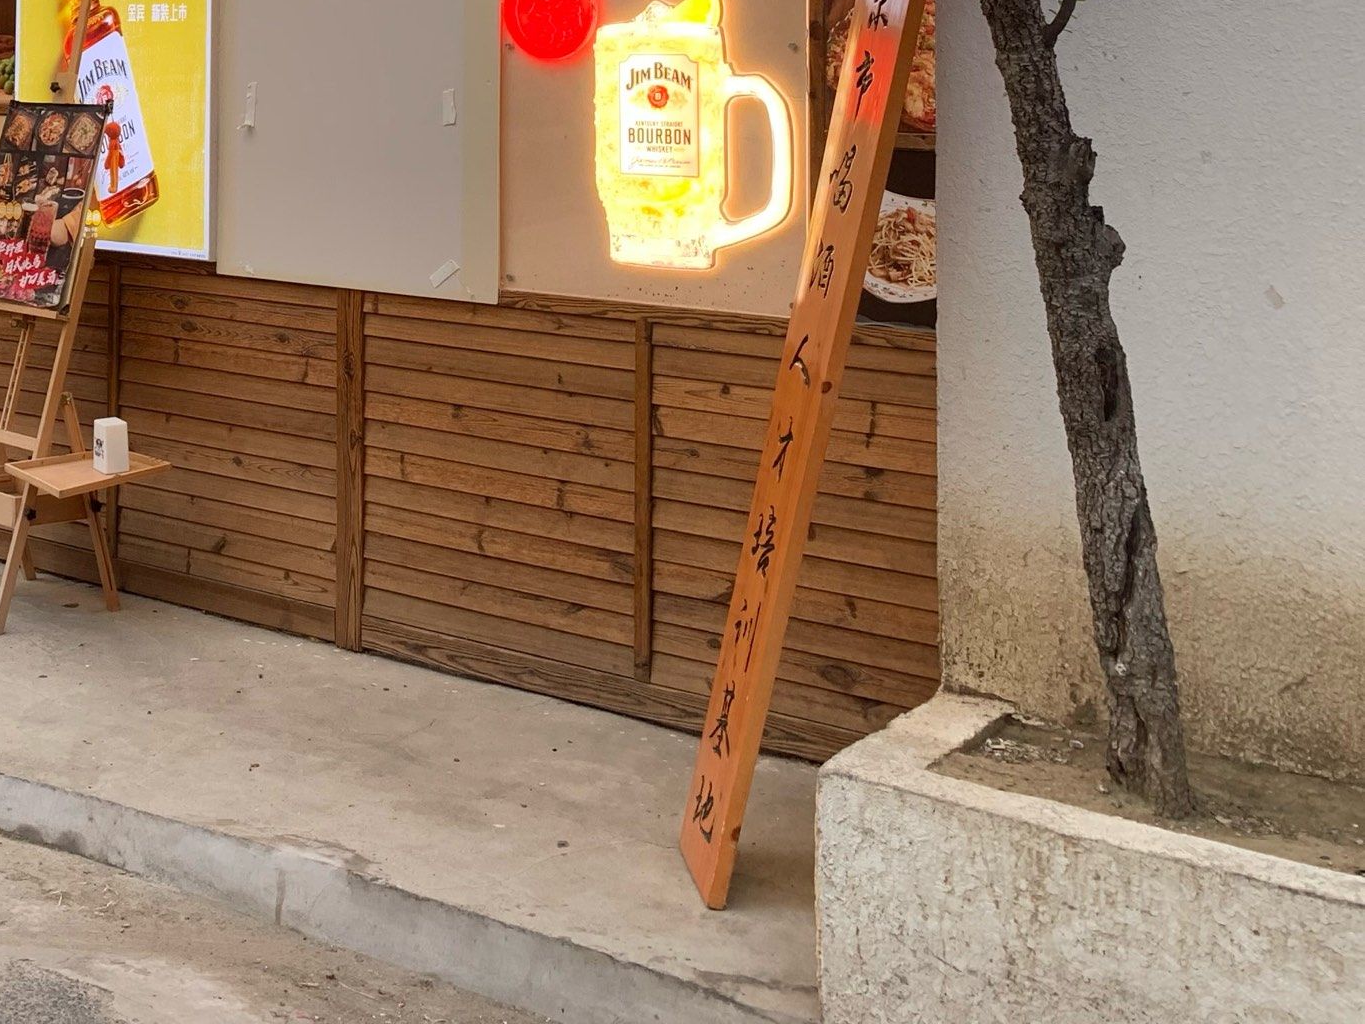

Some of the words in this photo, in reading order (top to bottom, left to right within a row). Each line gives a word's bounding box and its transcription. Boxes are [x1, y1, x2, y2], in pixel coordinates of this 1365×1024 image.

[78, 69, 96, 103] JIM
[93, 58, 128, 81] BEAM
[626, 67, 651, 91] JIM
[654, 61, 692, 93] BEAM
[628, 127, 692, 145] BOURBON
